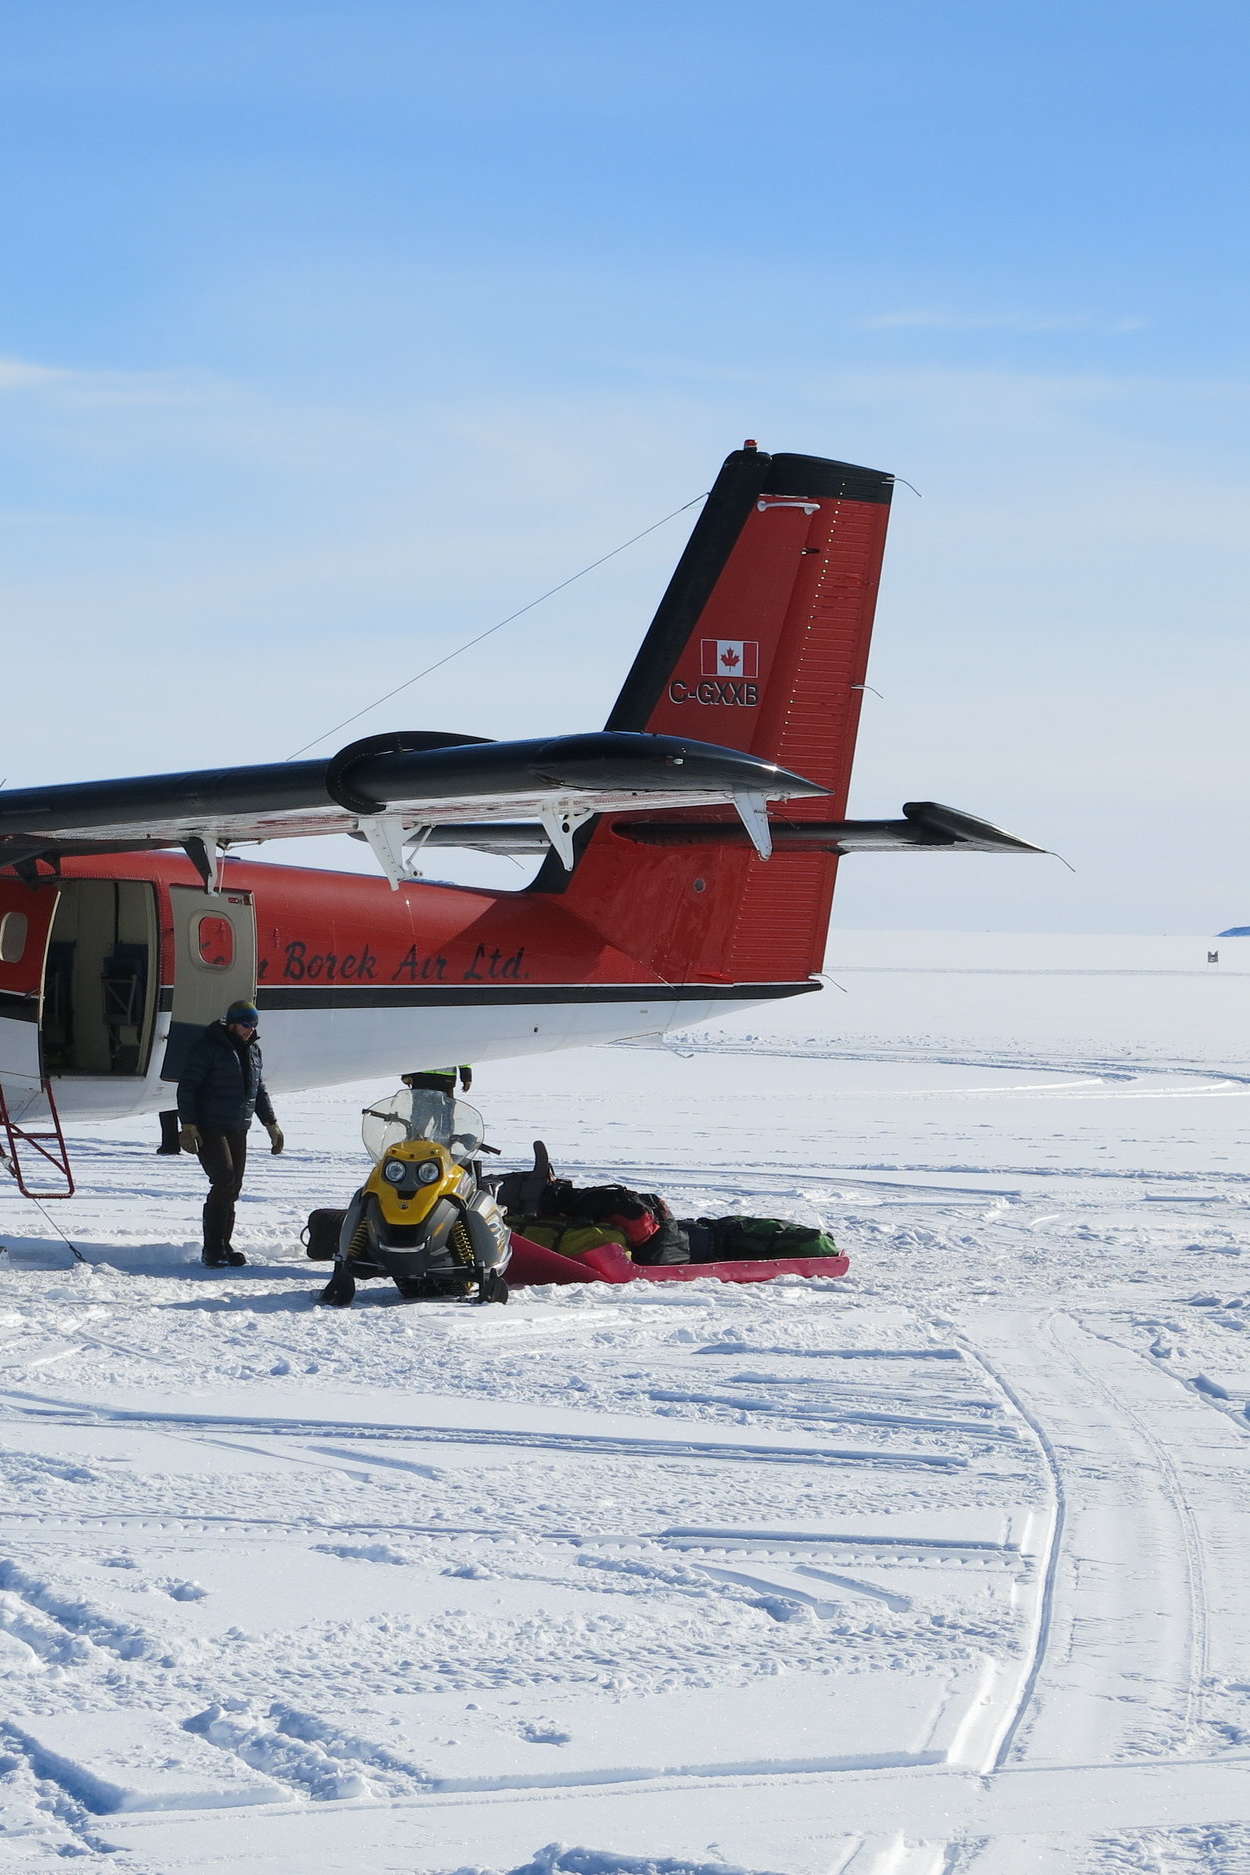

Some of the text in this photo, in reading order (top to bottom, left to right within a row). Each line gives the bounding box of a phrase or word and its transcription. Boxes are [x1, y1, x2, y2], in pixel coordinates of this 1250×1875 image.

[669, 681, 758, 706] C-GXXB
[283, 941, 379, 981] Borek
[391, 944, 448, 980] Air
[463, 943, 531, 980] Ltd.
